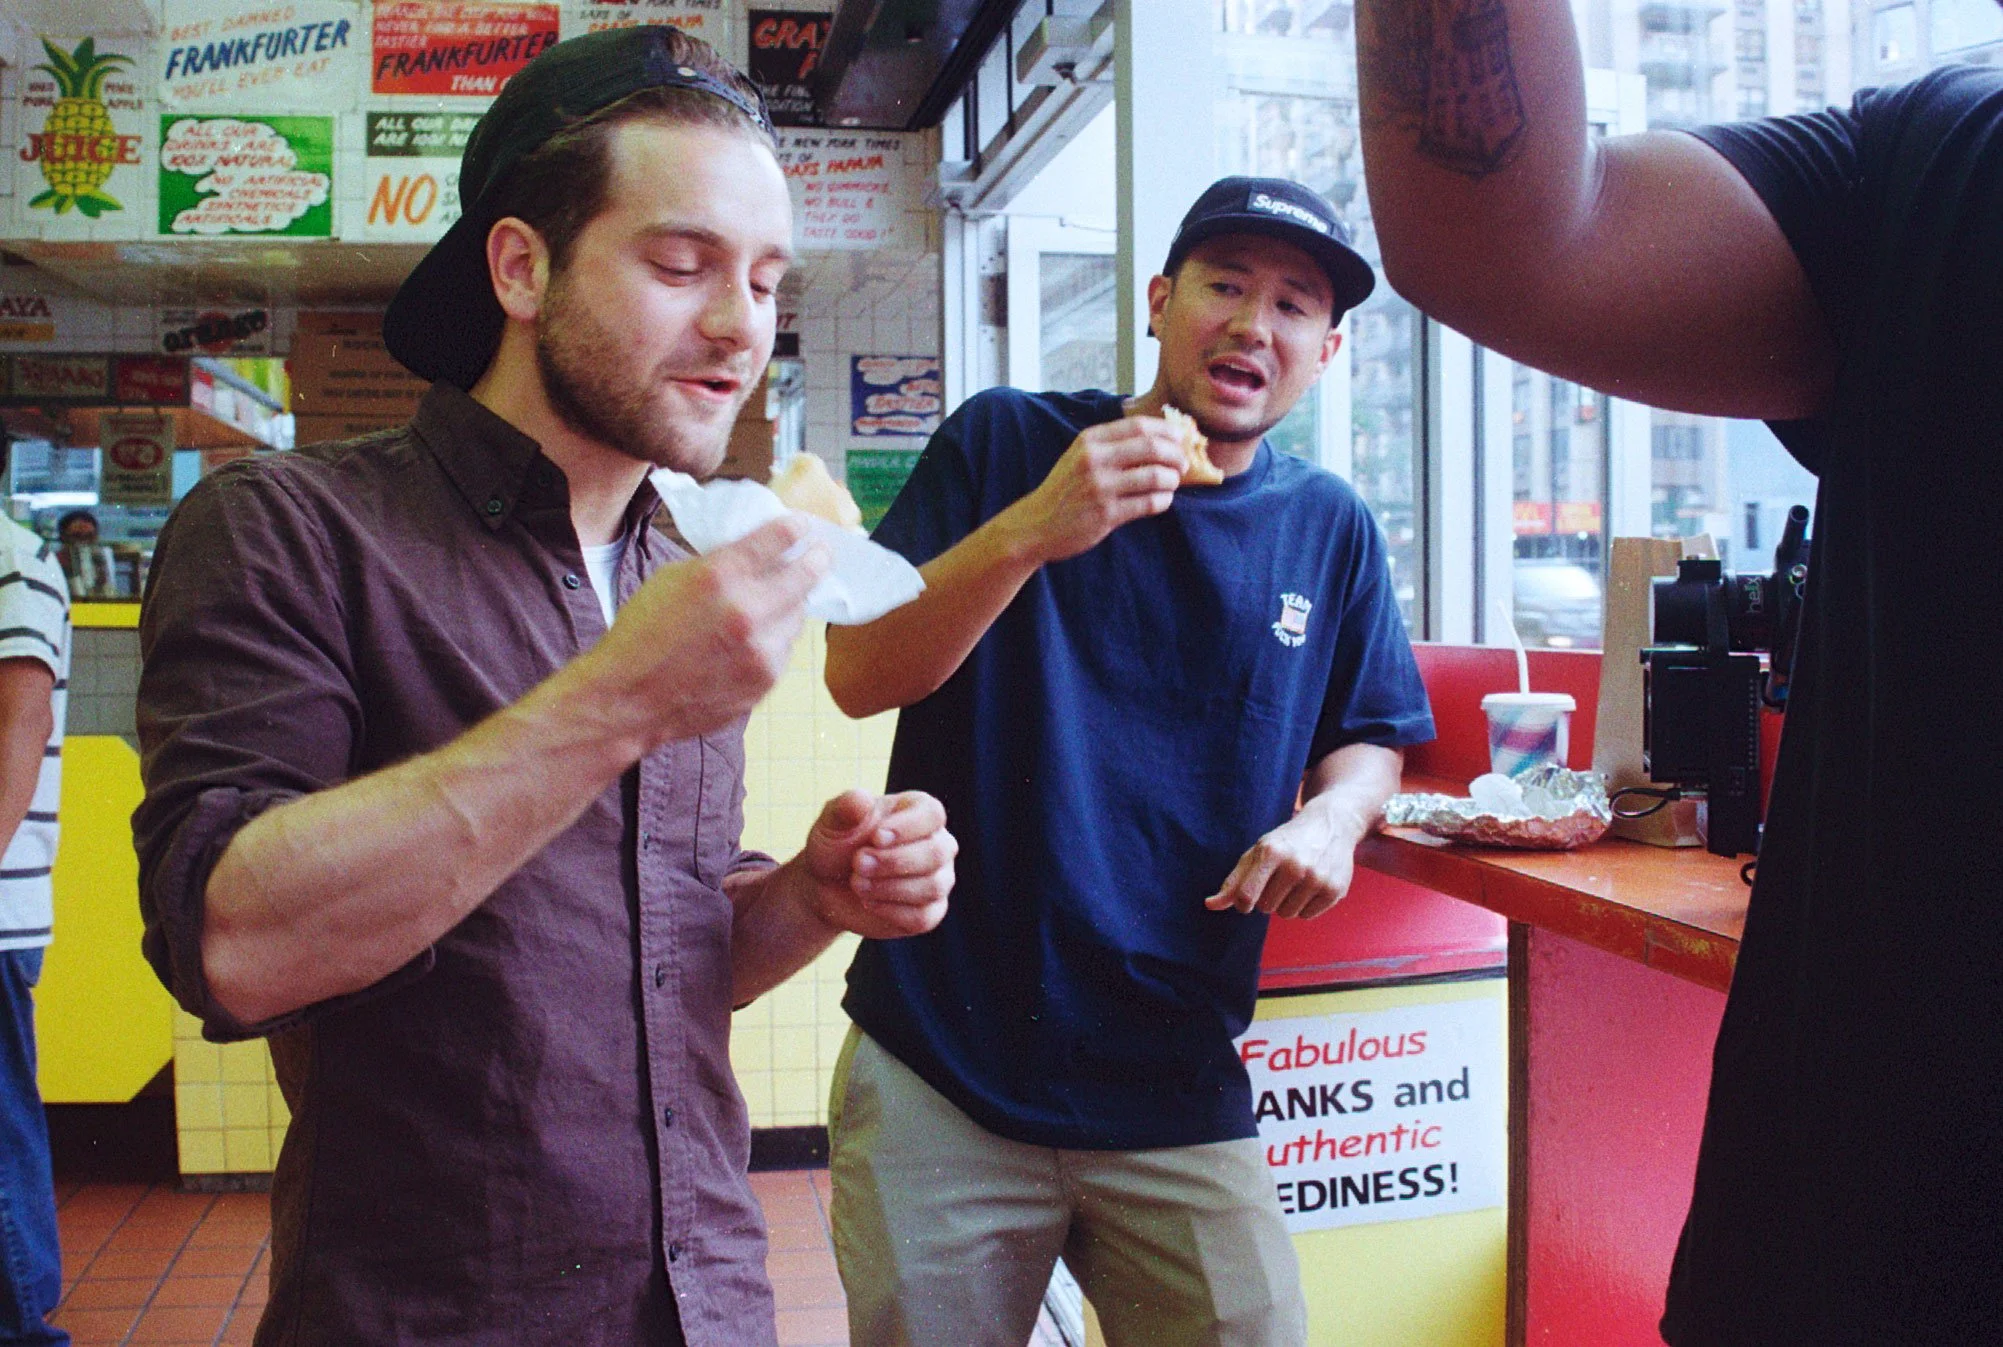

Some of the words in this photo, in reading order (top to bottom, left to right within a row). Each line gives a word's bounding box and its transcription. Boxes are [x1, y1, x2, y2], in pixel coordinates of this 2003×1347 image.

[171, 20, 211, 41] BEST
[221, 6, 295, 32] DAMNED
[165, 18, 351, 80] FRANKFURTER
[377, 31, 558, 80] FRANKFURTER
[294, 58, 330, 78] EAT
[451, 74, 497, 92] THAN
[186, 125, 212, 137] ALL
[223, 125, 258, 137] OUR
[375, 116, 405, 131] ALL
[411, 116, 444, 131] OUR
[20, 133, 142, 164] JUICE
[165, 139, 230, 152] DRINKS
[244, 139, 282, 152] ARE
[373, 132, 409, 146] ARE
[793, 137, 821, 148] NEW
[827, 137, 856, 148] YORK
[865, 138, 900, 150] TIMES
[215, 154, 294, 168] NATURAL
[827, 155, 884, 173] PAPAYA
[213, 174, 234, 185] NO
[244, 174, 323, 187] ARTIFICIAL
[230, 189, 313, 200] CHEMICALS
[367, 172, 439, 226] NO
[827, 198, 857, 209] BULL
[1253, 193, 1328, 234] Supreme
[0, 296, 52, 317] AYA
[1240, 1027, 1428, 1072] Fabulous
[1255, 1079, 1375, 1124] ANKS
[1394, 1066, 1470, 1109] and
[1266, 1119, 1443, 1168] uthentic
[1276, 1162, 1459, 1215] EDINESS!
